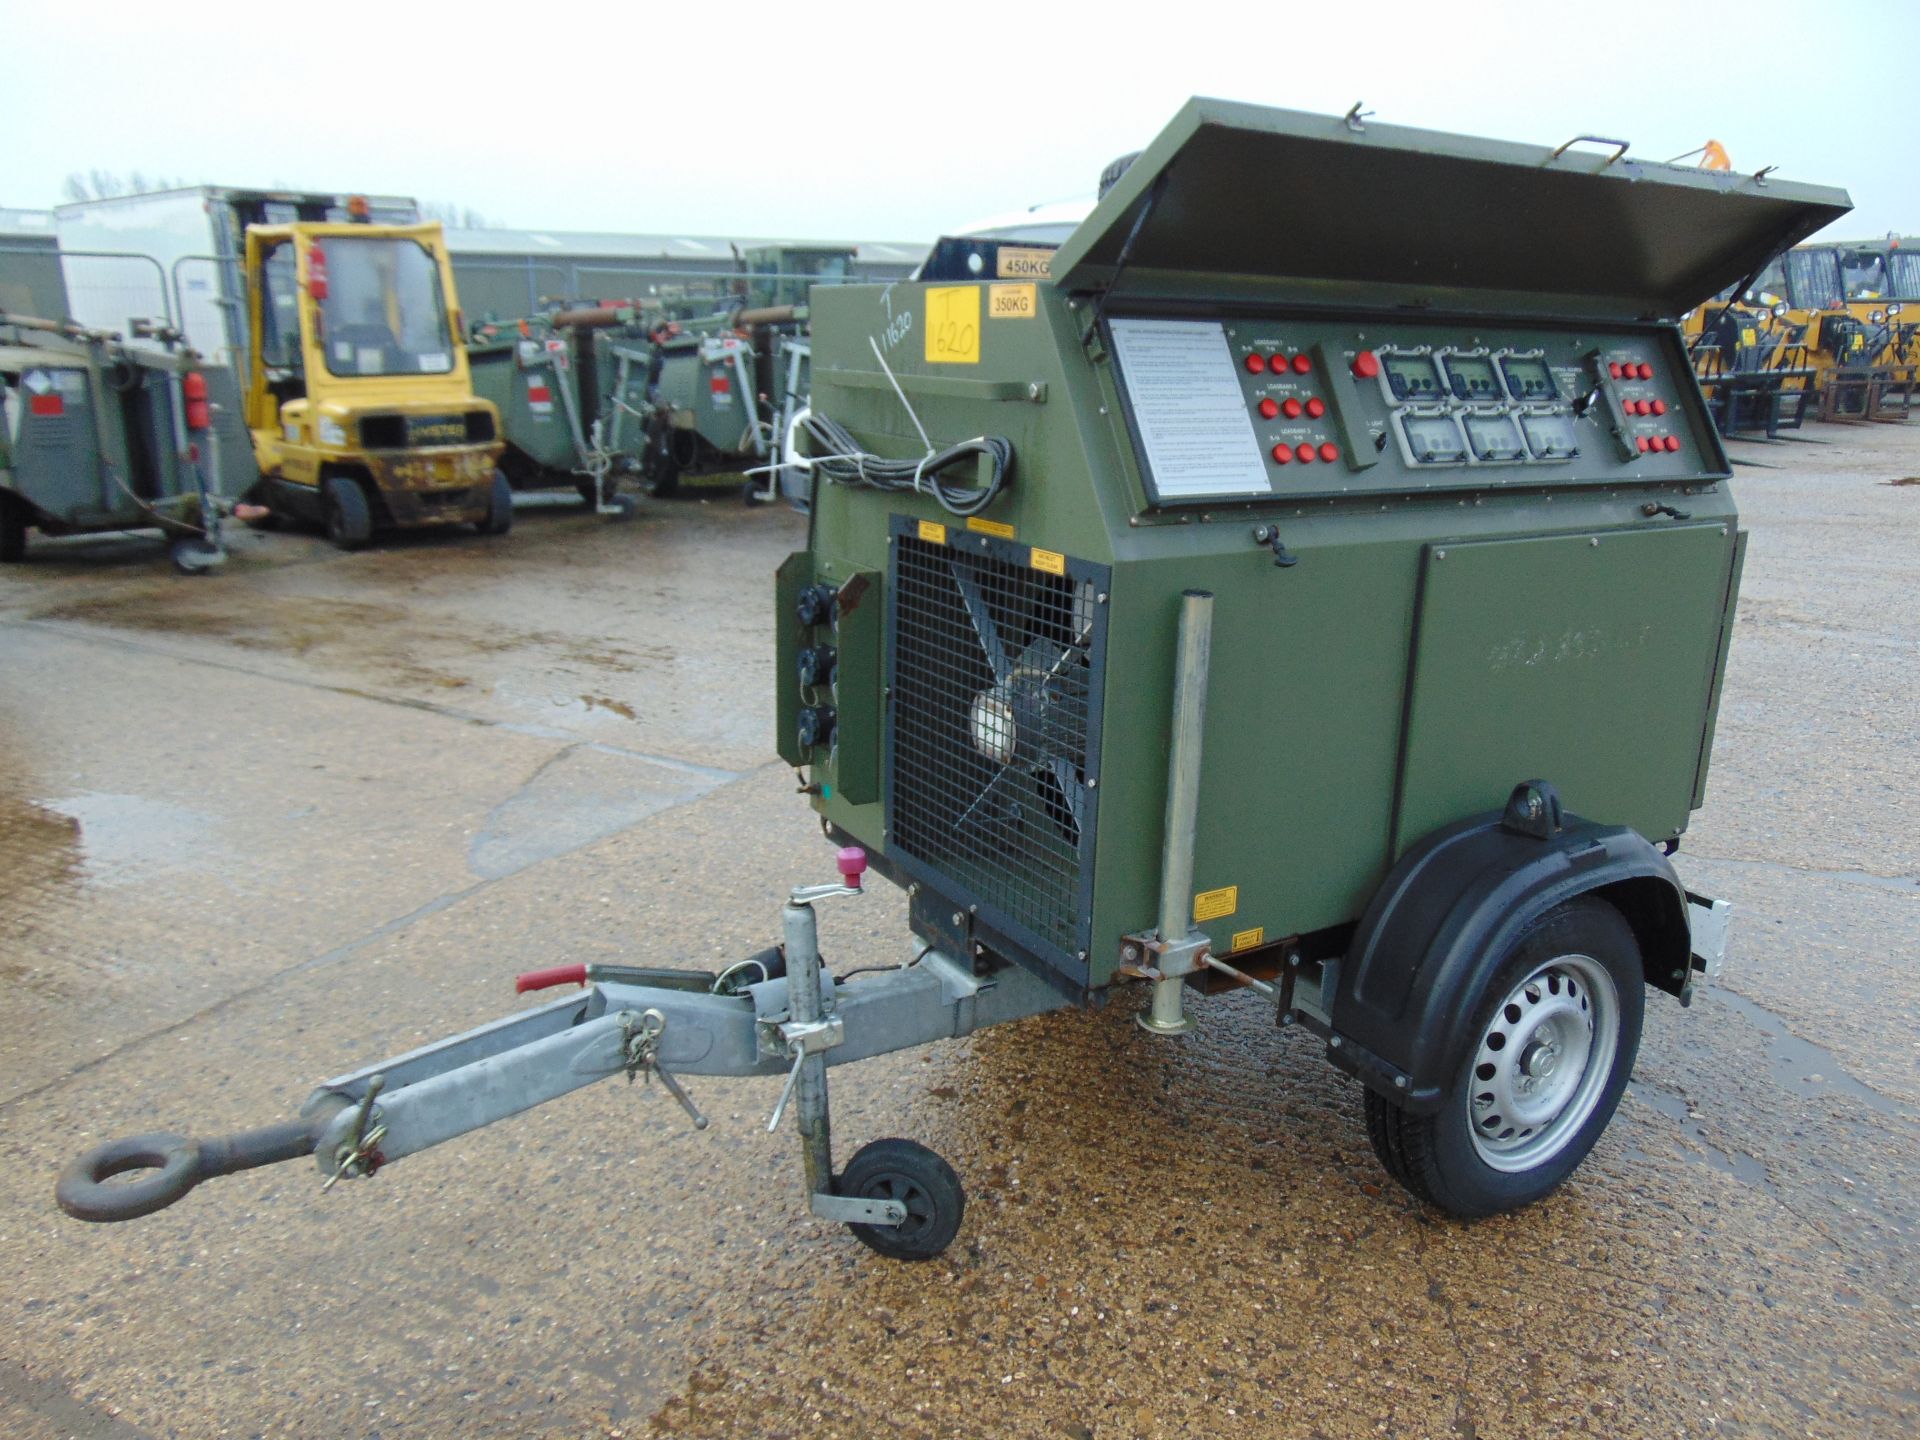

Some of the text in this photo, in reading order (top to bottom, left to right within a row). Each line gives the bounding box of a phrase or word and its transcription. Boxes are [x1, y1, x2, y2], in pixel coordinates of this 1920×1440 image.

[1006, 259, 1049, 274] 450KG
[936, 289, 960, 321] T
[995, 296, 1029, 312] 350KG
[881, 311, 913, 353] 11620
